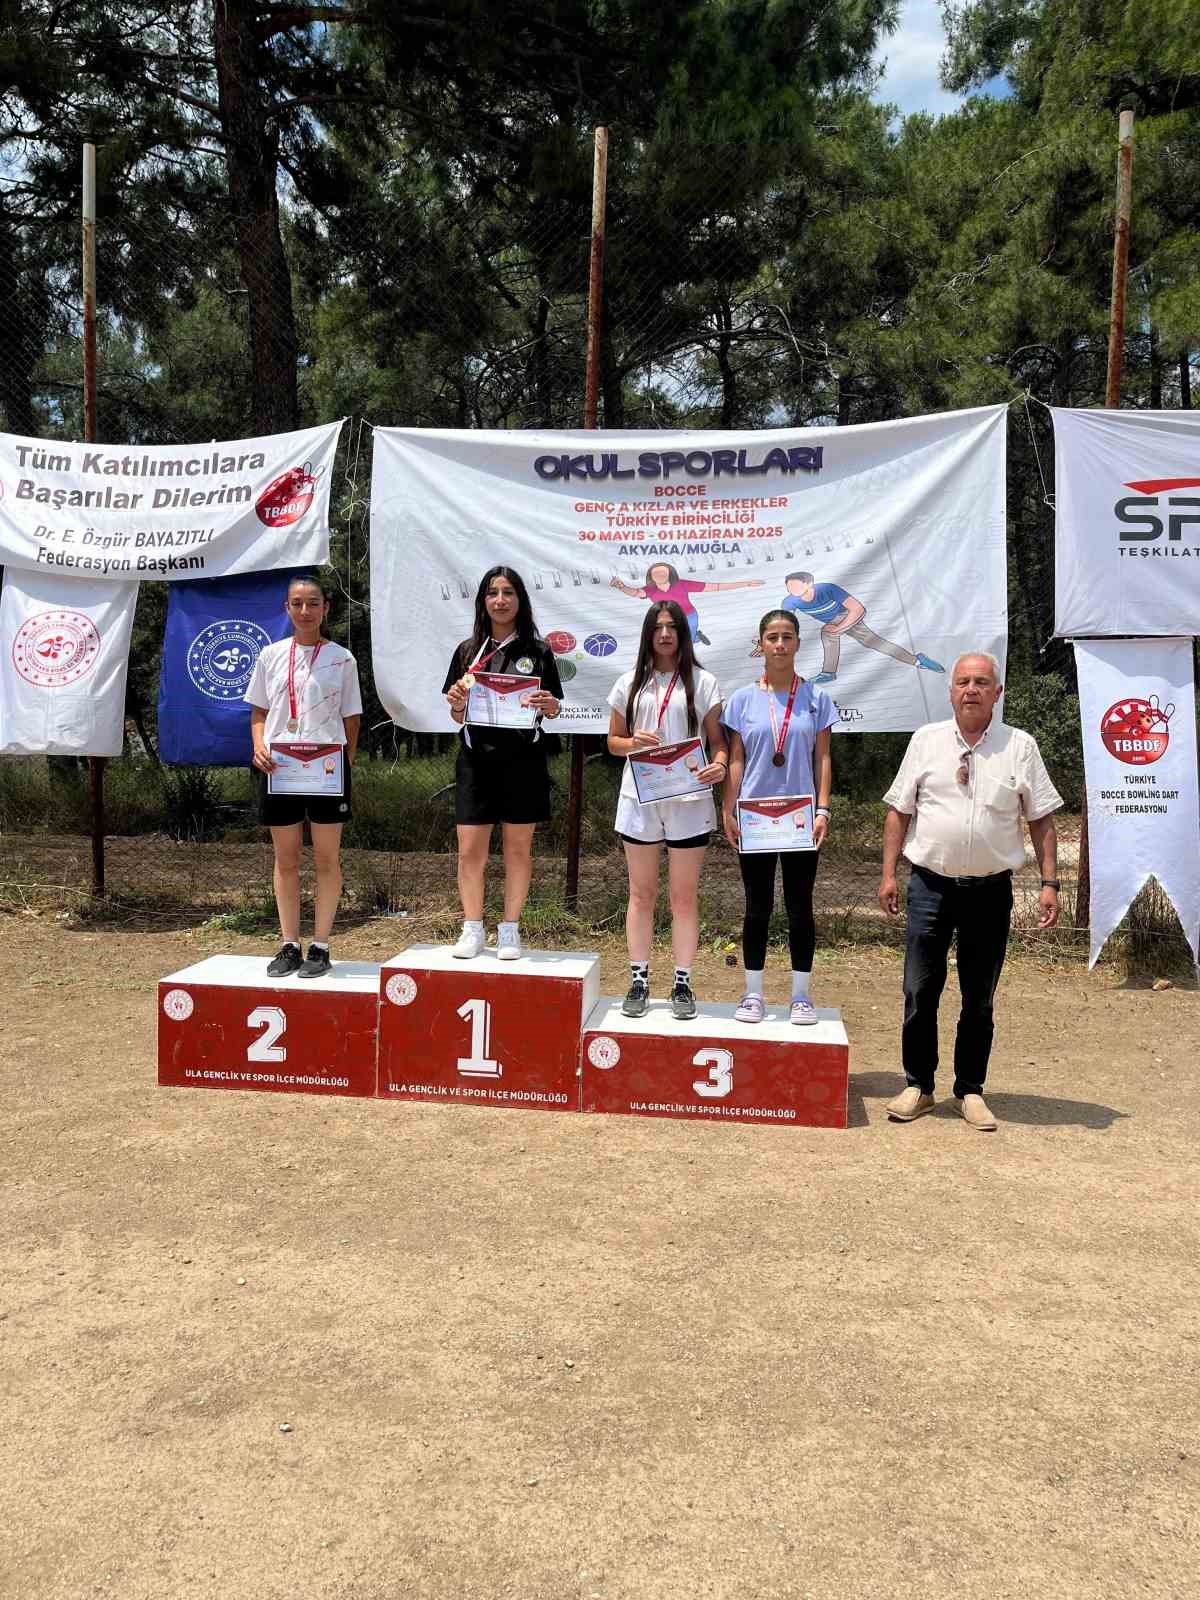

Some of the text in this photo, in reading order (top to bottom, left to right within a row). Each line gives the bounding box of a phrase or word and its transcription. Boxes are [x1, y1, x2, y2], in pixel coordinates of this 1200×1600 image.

[16, 445, 266, 477] Tüm Katılımcılara
[534, 446, 824, 481] OKUL SPORLARI
[16, 480, 252, 510] Başarılar Dilerim
[654, 484, 706, 496] BOCCE
[574, 497, 788, 514] GENÇ A KIZLAR VE ERKEKLER
[606, 510, 755, 527] TÜRKİYE BİRİNCİLİĞİ
[33, 525, 213, 549] Dr. E. Özgür BAYAZITLI
[578, 531, 596, 541] 30
[599, 530, 644, 541] MAYIS
[658, 530, 674, 540] 01
[678, 526, 744, 540] HAZİRAN
[748, 526, 783, 538] 2025
[618, 542, 741, 556] AKYAKA/MUĞLA
[1118, 547, 1200, 558] TEŞKİLAT
[37, 548, 205, 571] Federasyon Başkanı
[1113, 739, 1160, 752] TBBDF
[1124, 774, 1156, 784] TÜRKİYE
[1101, 790, 1126, 799] BOCCE
[1162, 790, 1179, 799] DART
[1116, 805, 1168, 814] FEDERASYONU
[247, 1006, 286, 1062] 2
[457, 998, 502, 1079] 1
[186, 1069, 349, 1086] ULA GENÇLİK VE SPOR İLÇE MÜDÜRLÜĞÜ
[692, 1048, 734, 1098] 3
[389, 1084, 568, 1103] ULA GENÇLİK VE SPOR İLÇE MÜDÜRLÜĞÜ
[630, 1102, 646, 1110] ULA
[648, 1102, 684, 1112] GENÇLİK
[698, 1106, 720, 1114] SPOR
[722, 1106, 740, 1116] İLÇE
[742, 1108, 796, 1118] MÜDÜRLÜĞÜ
